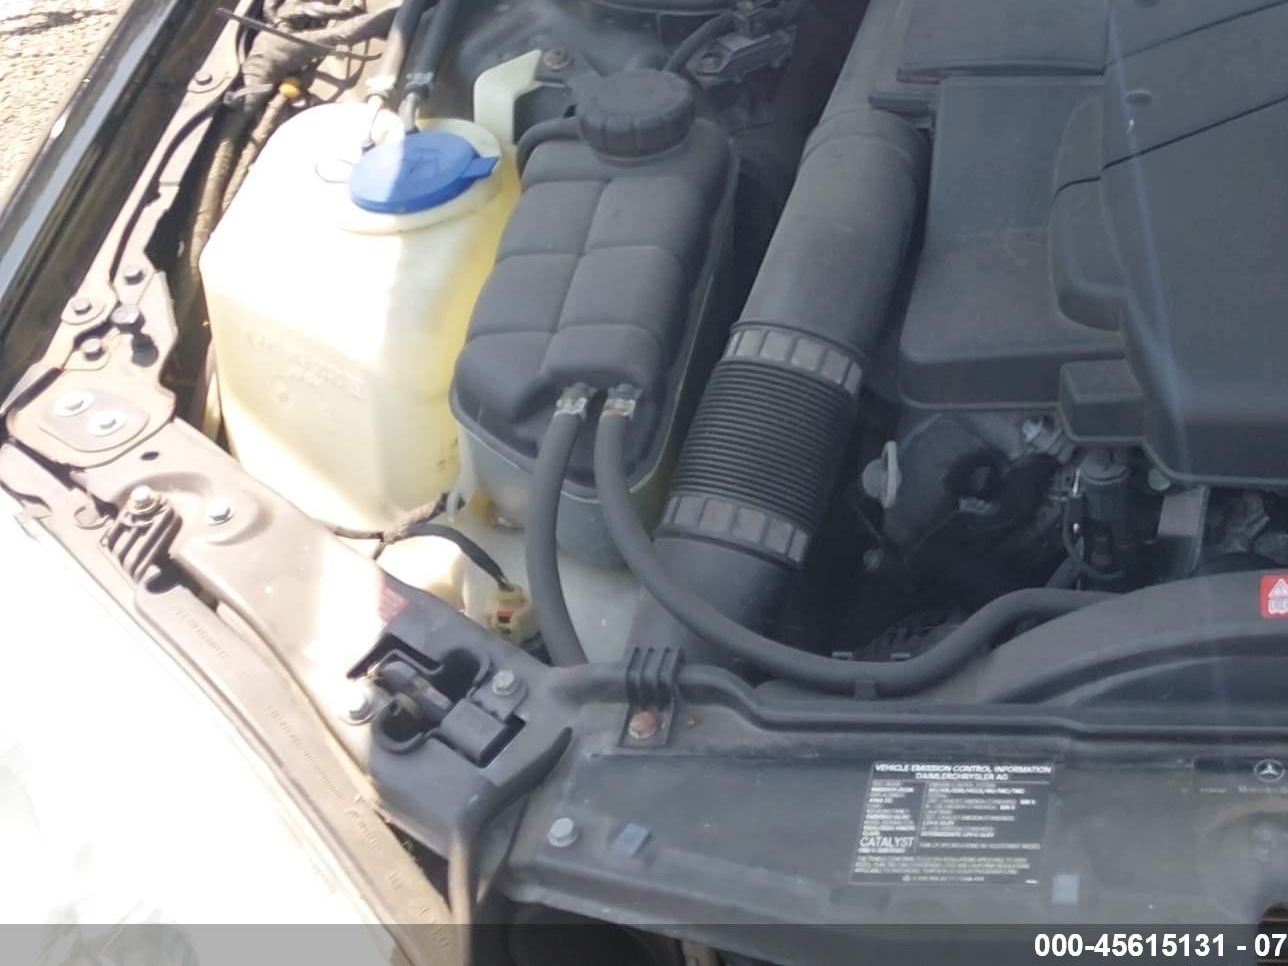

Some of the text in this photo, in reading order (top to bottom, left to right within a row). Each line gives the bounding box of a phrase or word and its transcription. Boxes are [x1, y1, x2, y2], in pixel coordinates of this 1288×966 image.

[874, 764, 1051, 773] VEHICLE EMISSION CONTROL INFORMATION
[860, 837, 914, 847] CATALYST
